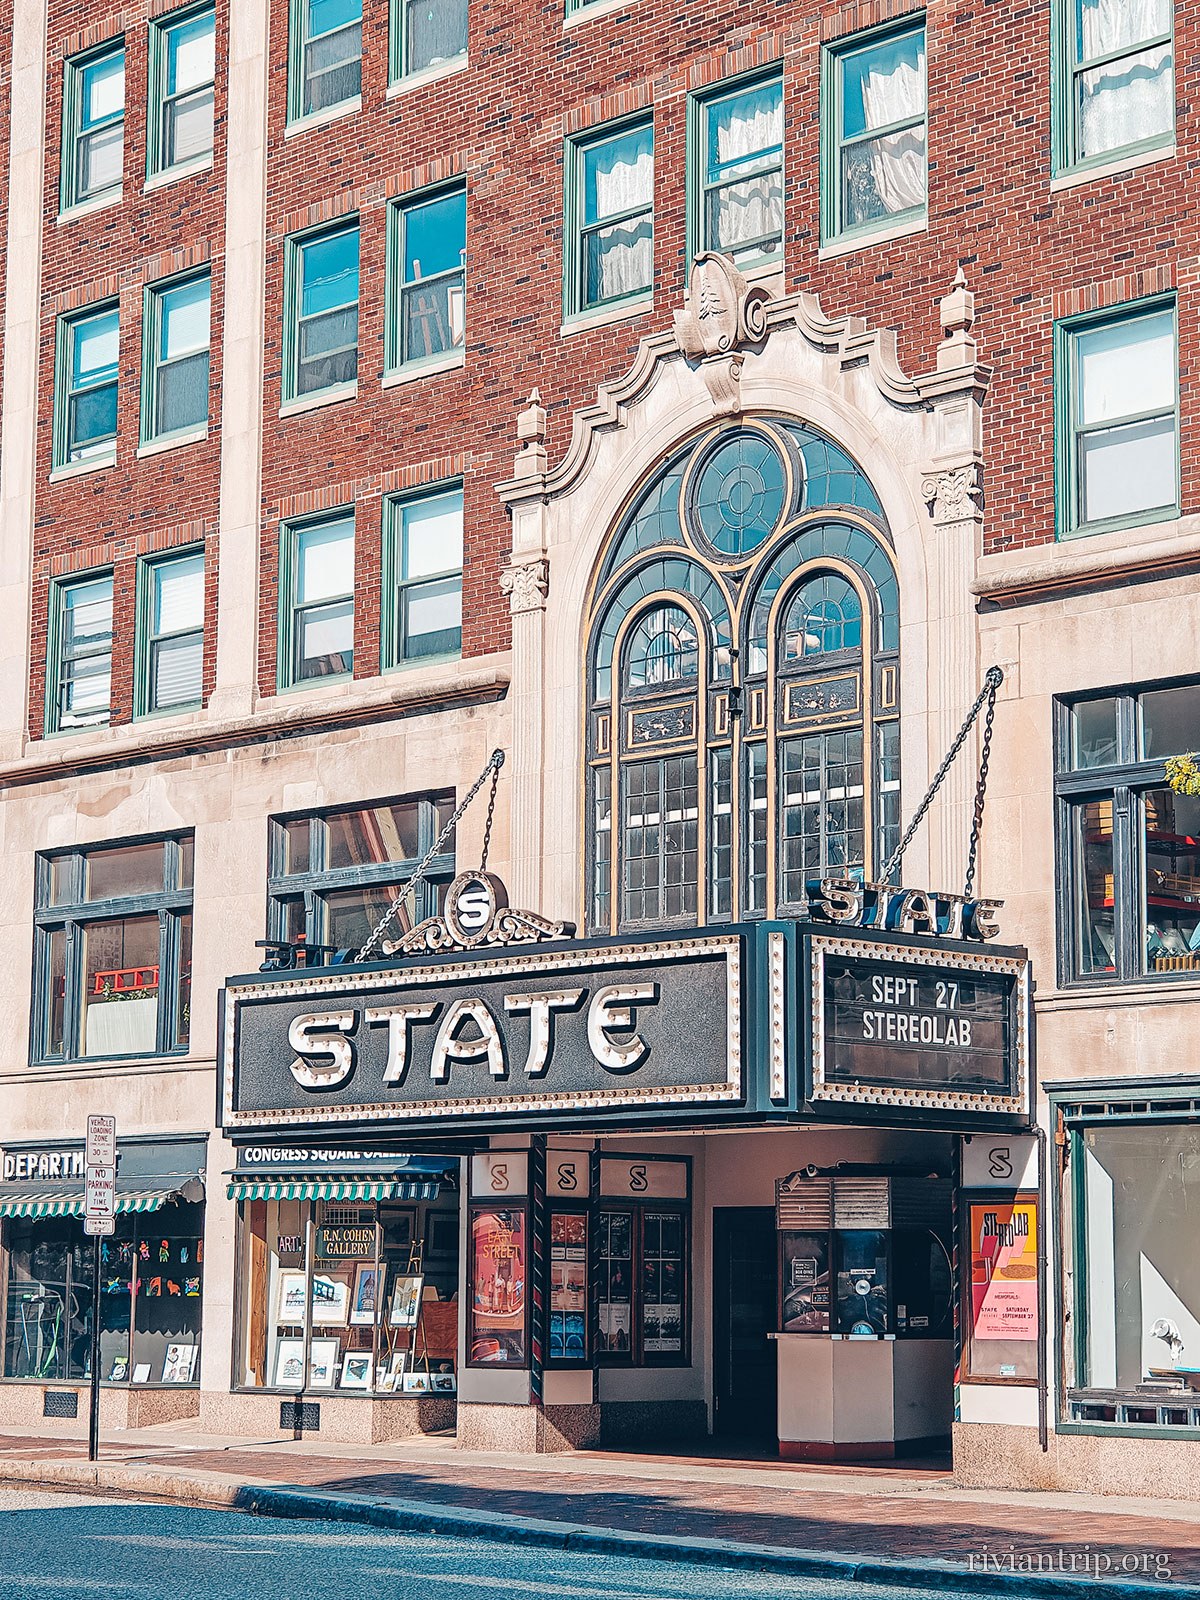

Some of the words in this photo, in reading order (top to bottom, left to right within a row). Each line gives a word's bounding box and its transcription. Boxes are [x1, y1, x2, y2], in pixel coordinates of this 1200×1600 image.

[457, 891, 490, 928] S
[806, 878, 1004, 939] STATE
[872, 975, 918, 1006] SEPT
[935, 981, 959, 1010] 27
[863, 1011, 972, 1046] STEREOLAB
[288, 982, 660, 1093] STATE
[90, 1119, 113, 1127] VEHICLE
[90, 1127, 113, 1135] LOADING
[94, 1134, 108, 1142] ZONE
[92, 1148, 101, 1156] 30
[244, 1147, 308, 1162] CONGRESS
[4, 1151, 120, 1178] DEPARTM
[989, 1148, 1013, 1178] S
[95, 1169, 107, 1178] NO
[491, 1163, 509, 1191] S
[557, 1163, 578, 1191] S
[629, 1165, 649, 1192] S
[88, 1180, 113, 1190] PARKING
[93, 1198, 107, 1206] TIME
[323, 1229, 341, 1242] R.N.
[343, 1229, 375, 1242] COHEN
[326, 1242, 371, 1255] GALLERY
[482, 1244, 521, 1259] STREET
